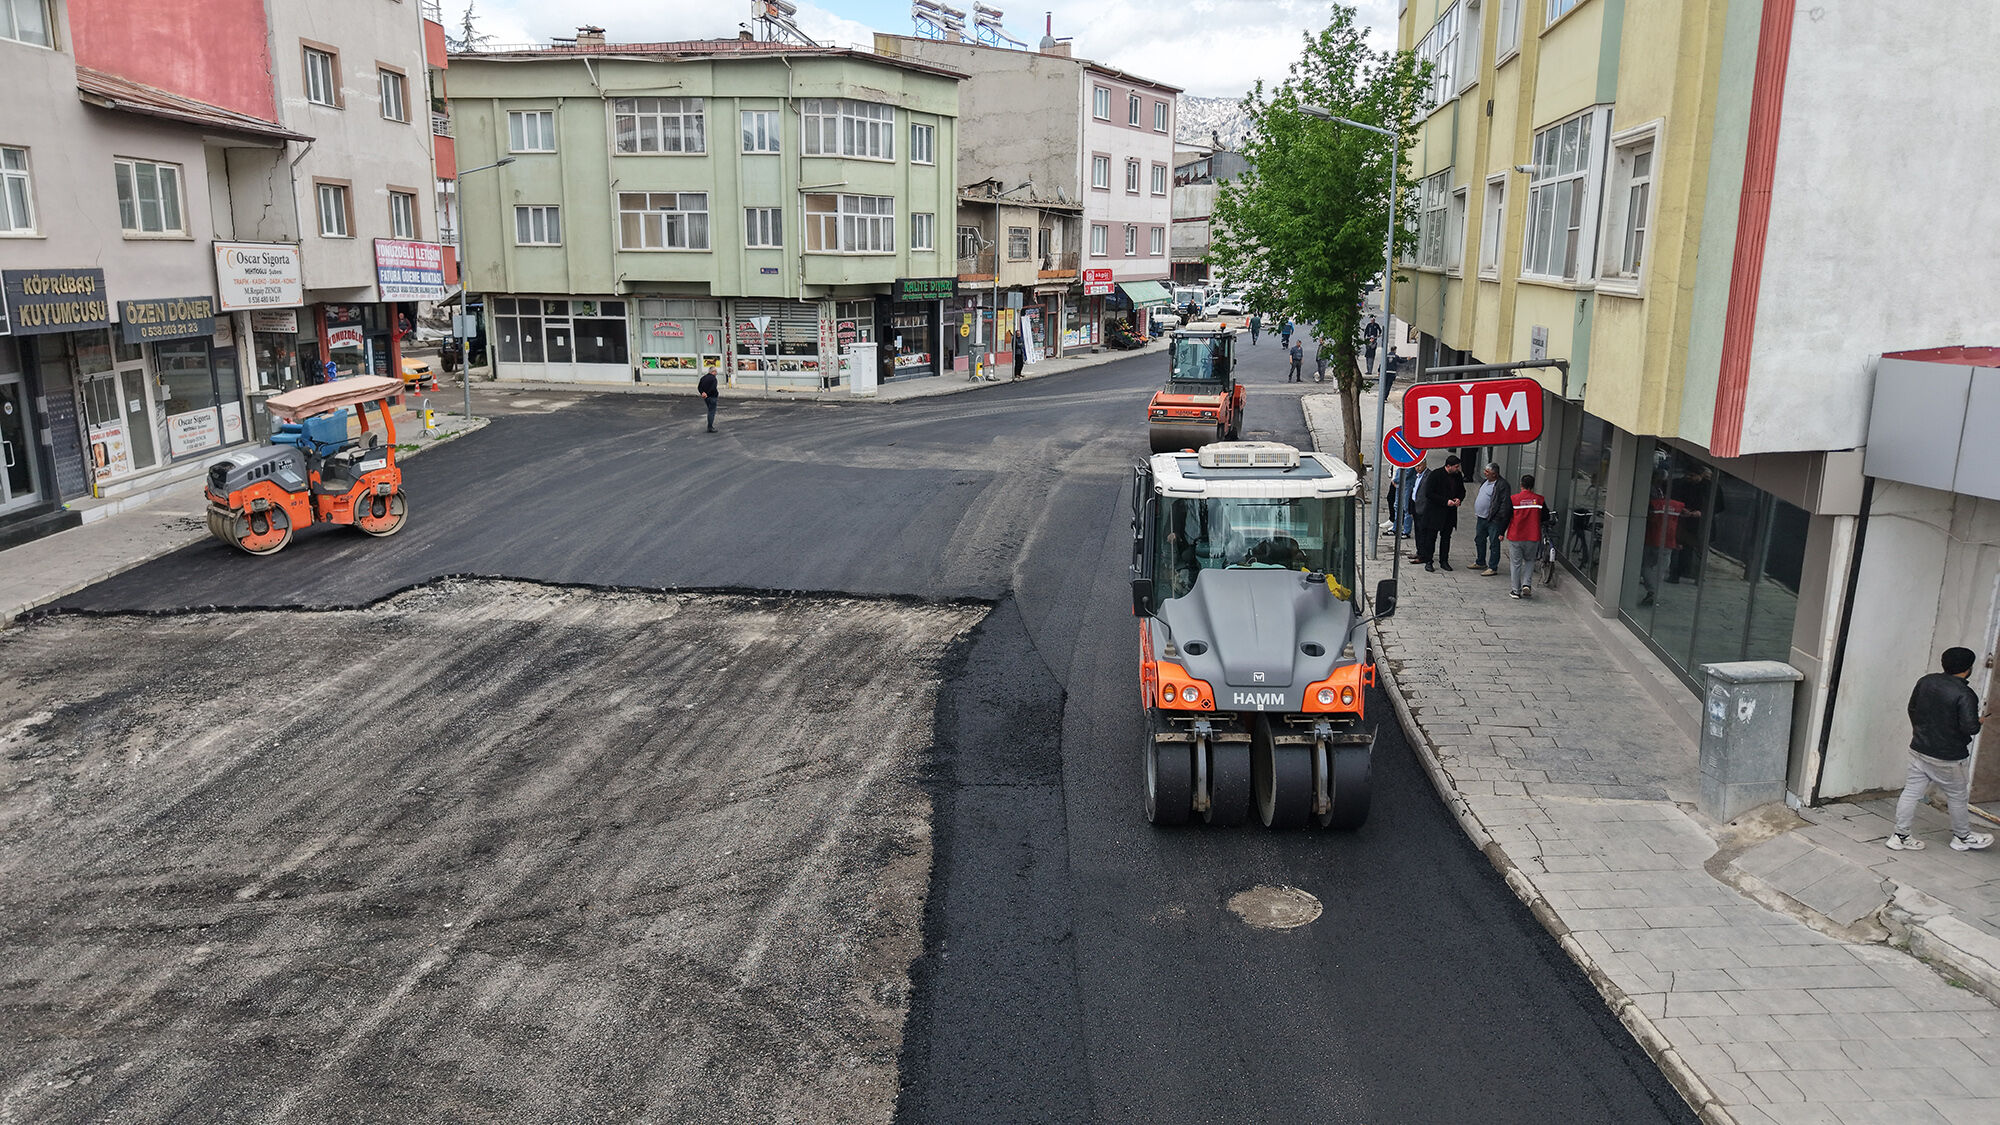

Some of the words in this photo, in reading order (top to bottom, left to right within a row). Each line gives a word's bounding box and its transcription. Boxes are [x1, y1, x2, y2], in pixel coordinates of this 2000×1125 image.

[236, 252, 260, 264] Oscar
[262, 252, 290, 267] Sigorta
[23, 274, 95, 295] KÖPRÜBAŞI
[380, 270, 401, 282] FATURA
[402, 268, 420, 282] ÖDEME
[421, 272, 442, 284] NOKTASI
[19, 301, 106, 327] KUYUMCUSU
[126, 301, 165, 324] ÖZEN
[167, 299, 212, 321] DÖNER
[141, 328, 147, 337] 0
[148, 326, 162, 337] 538
[163, 324, 177, 335] 203
[178, 323, 187, 333] 21
[188, 322, 198, 332] 23
[1418, 384, 1531, 438] BİM
[1233, 692, 1284, 706] HAMM
